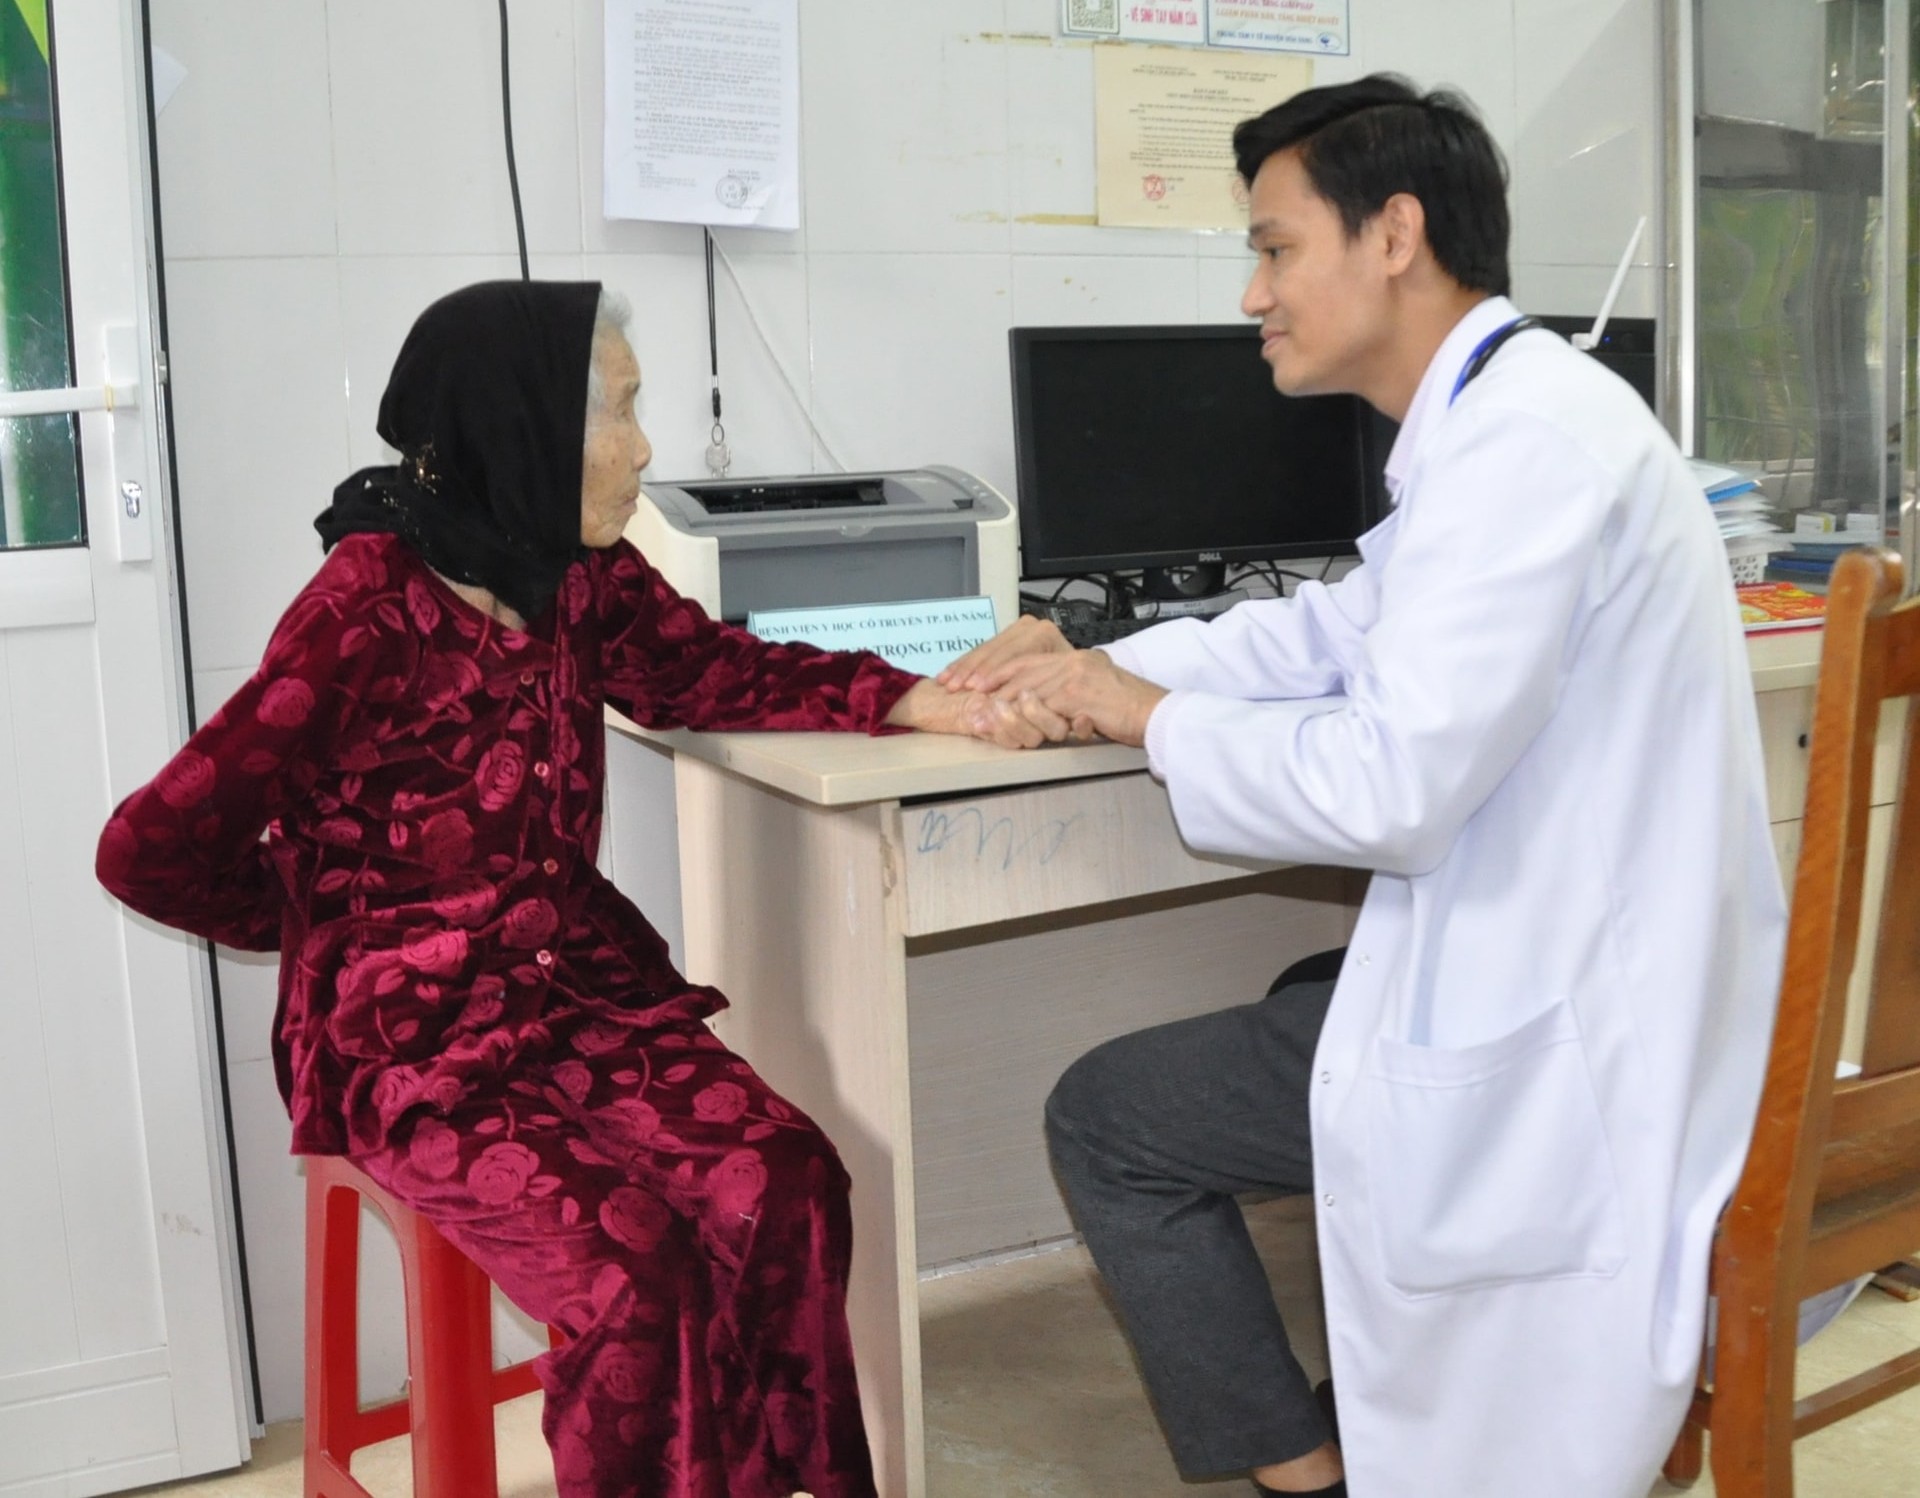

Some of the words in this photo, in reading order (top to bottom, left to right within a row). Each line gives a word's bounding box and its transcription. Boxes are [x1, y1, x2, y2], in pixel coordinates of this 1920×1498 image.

[1199, 552, 1222, 562] DELL
[758, 626, 789, 637] BỆNH
[792, 623, 819, 635] VIỆN
[822, 623, 829, 631] Y
[833, 621, 855, 632] HỌC
[926, 615, 942, 625] TP.
[873, 639, 932, 659] TRỌNG
